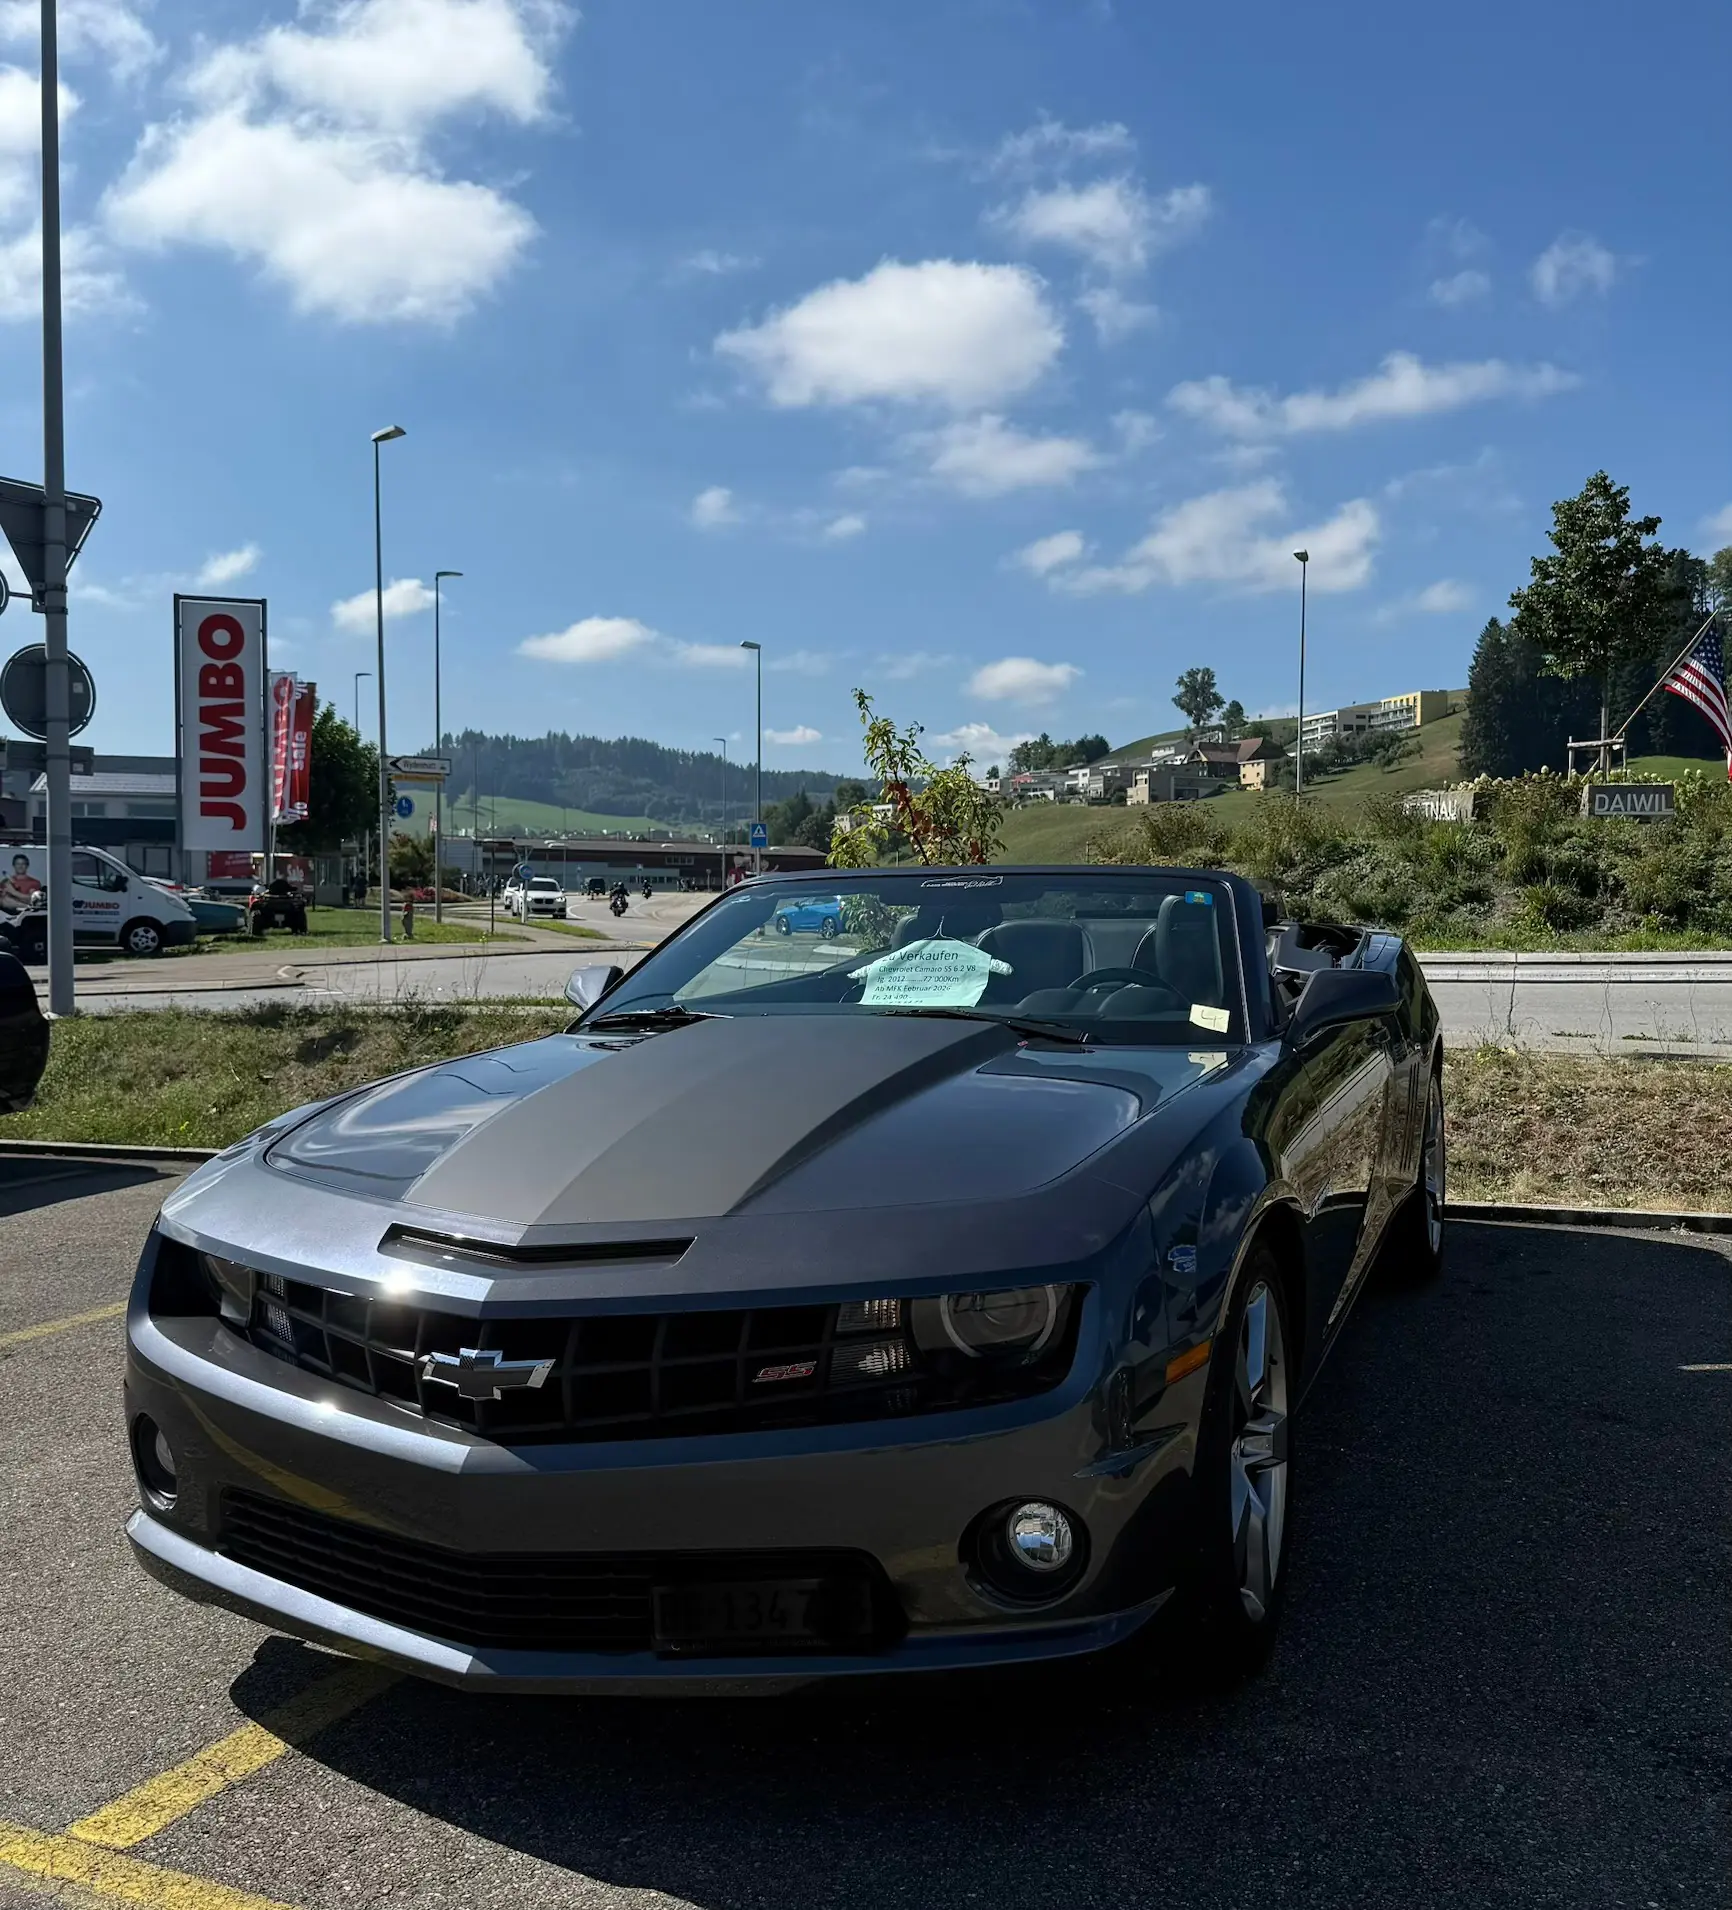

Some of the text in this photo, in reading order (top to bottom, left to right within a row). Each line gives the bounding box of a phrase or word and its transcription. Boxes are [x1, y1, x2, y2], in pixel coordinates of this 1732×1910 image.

[198, 613, 247, 830] JUMBO
[1595, 793, 1674, 812] DAIWIL
[84, 901, 120, 909] JUMBO
[900, 950, 958, 961] Verkaufen
[879, 965, 913, 973] Chevrolet
[914, 965, 942, 973] Camaro
[966, 964, 977, 972] V8
[752, 1361, 817, 1383] SS
